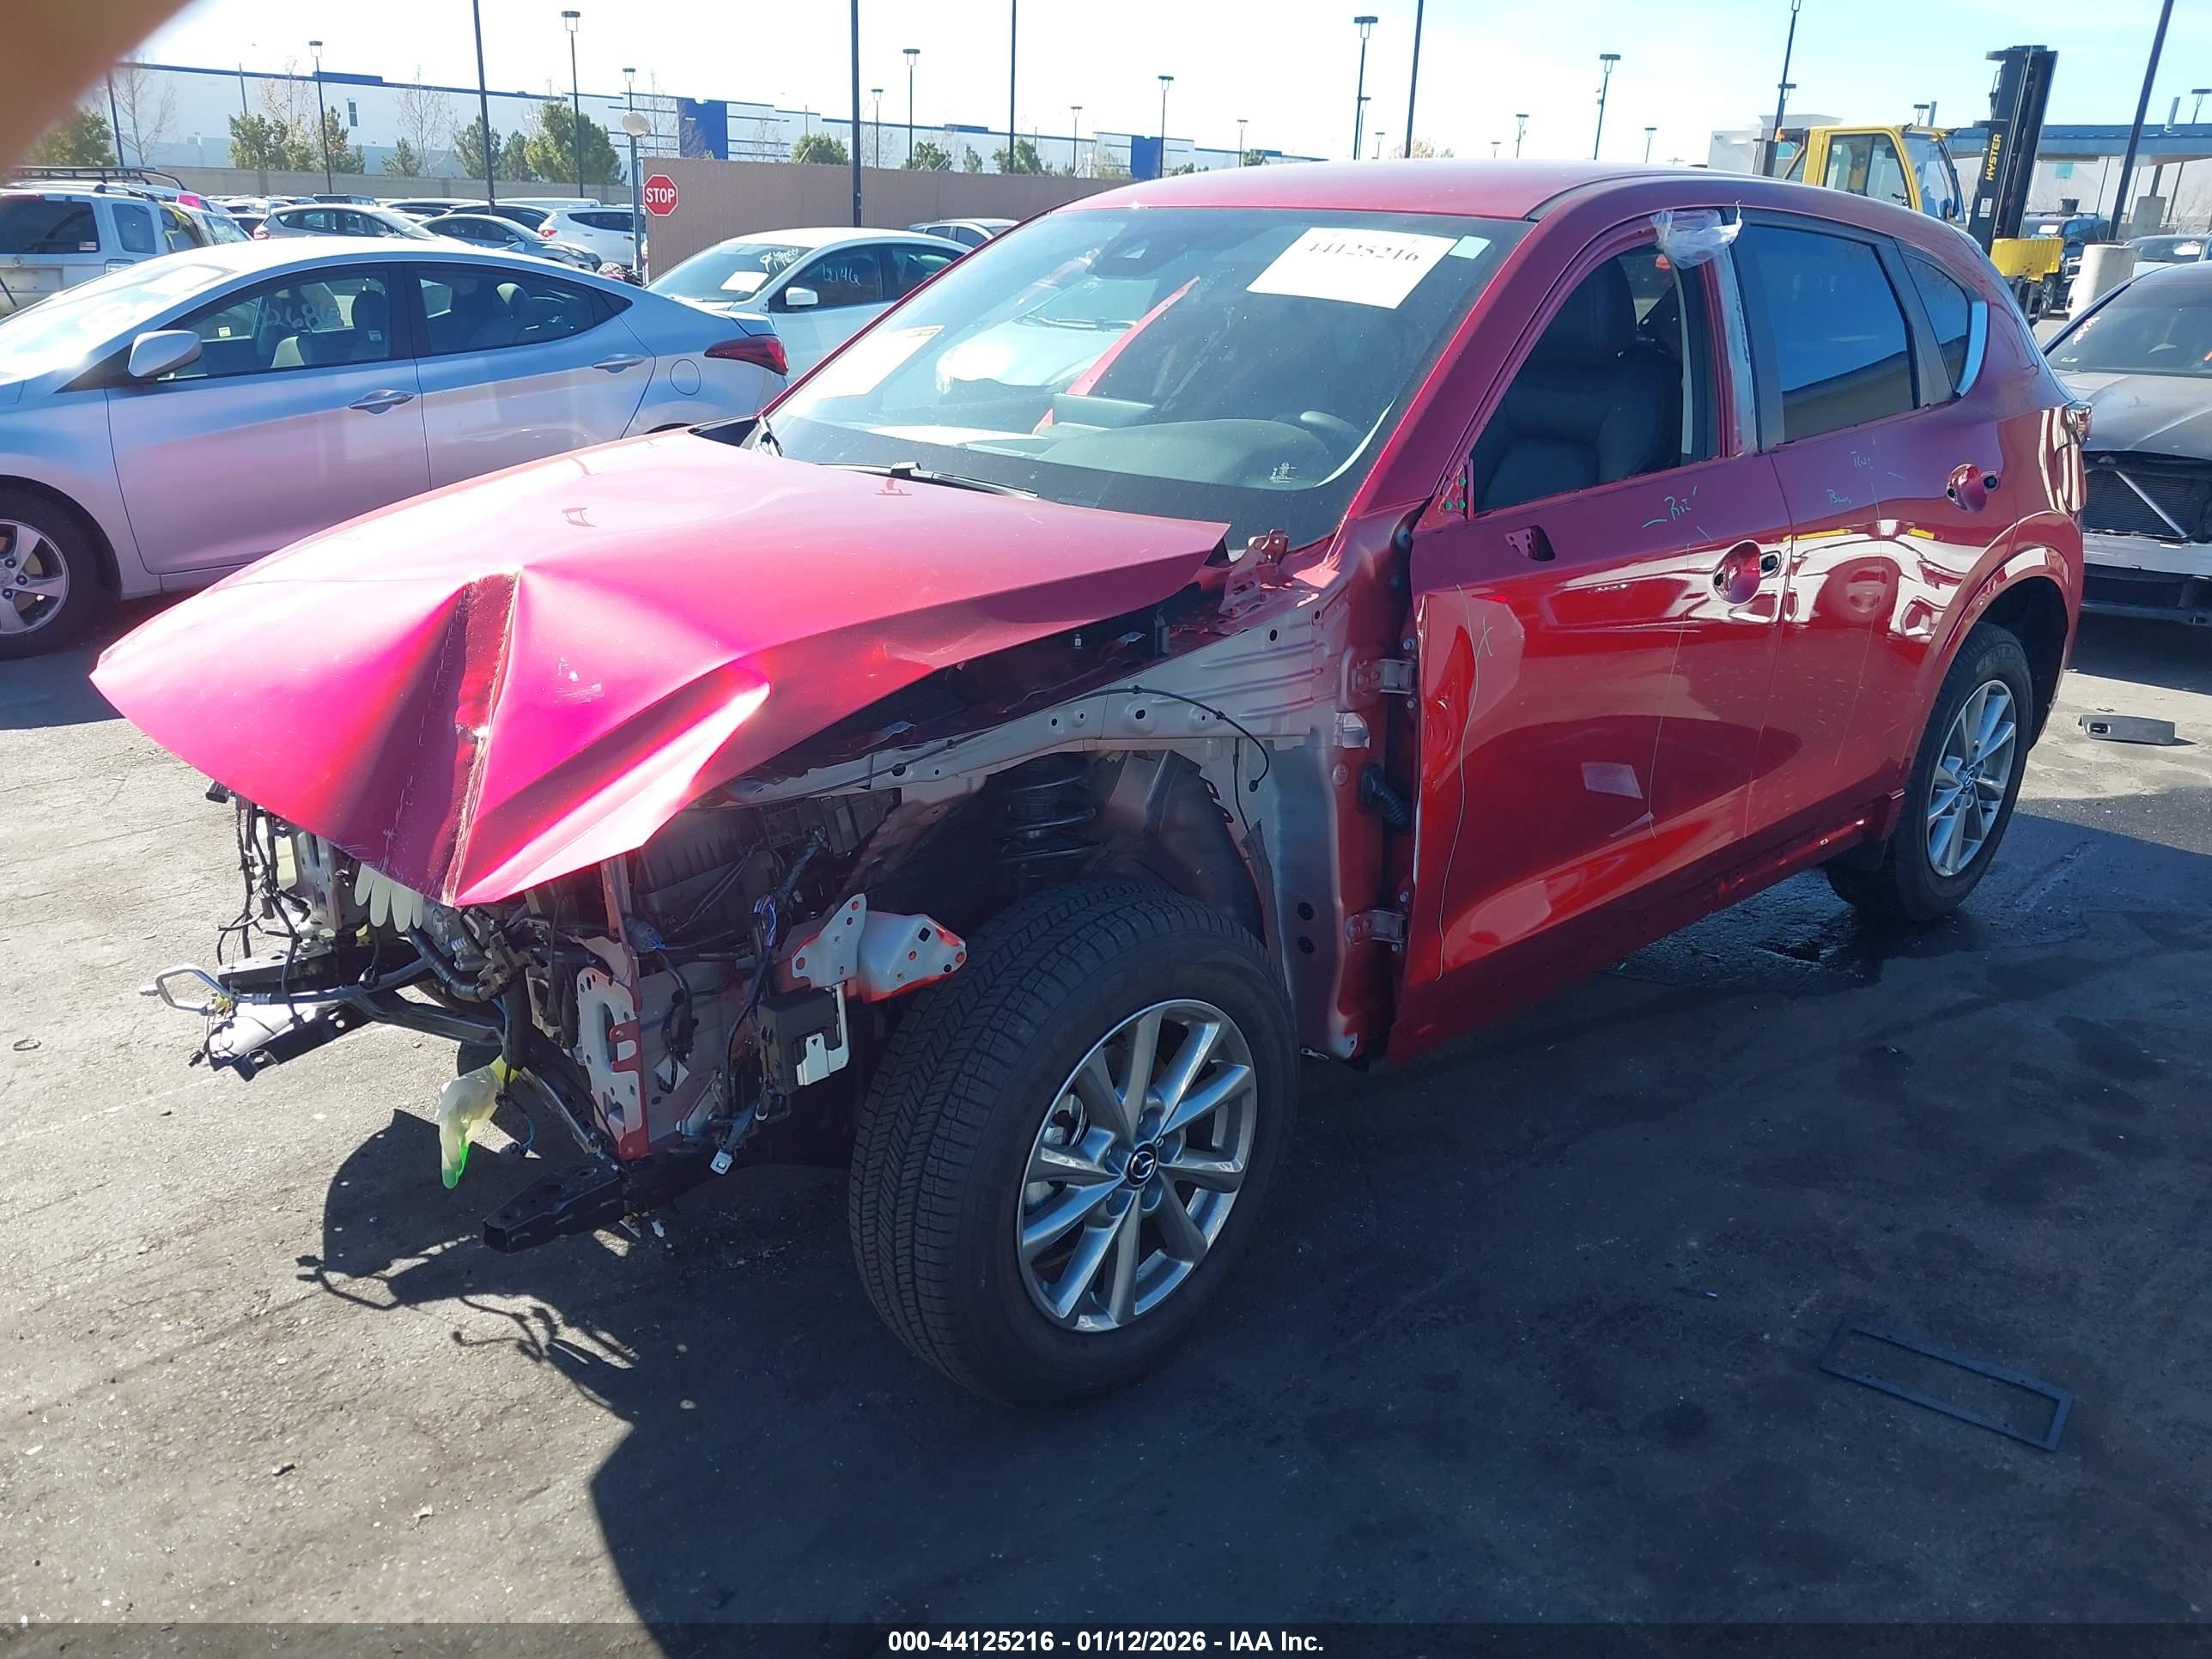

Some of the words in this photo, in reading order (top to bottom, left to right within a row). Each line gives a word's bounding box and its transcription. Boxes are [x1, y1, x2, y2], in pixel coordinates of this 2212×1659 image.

[1984, 133, 2002, 181] HYSTER
[646, 187, 675, 204] STOP
[1304, 241, 1419, 261] 44125216
